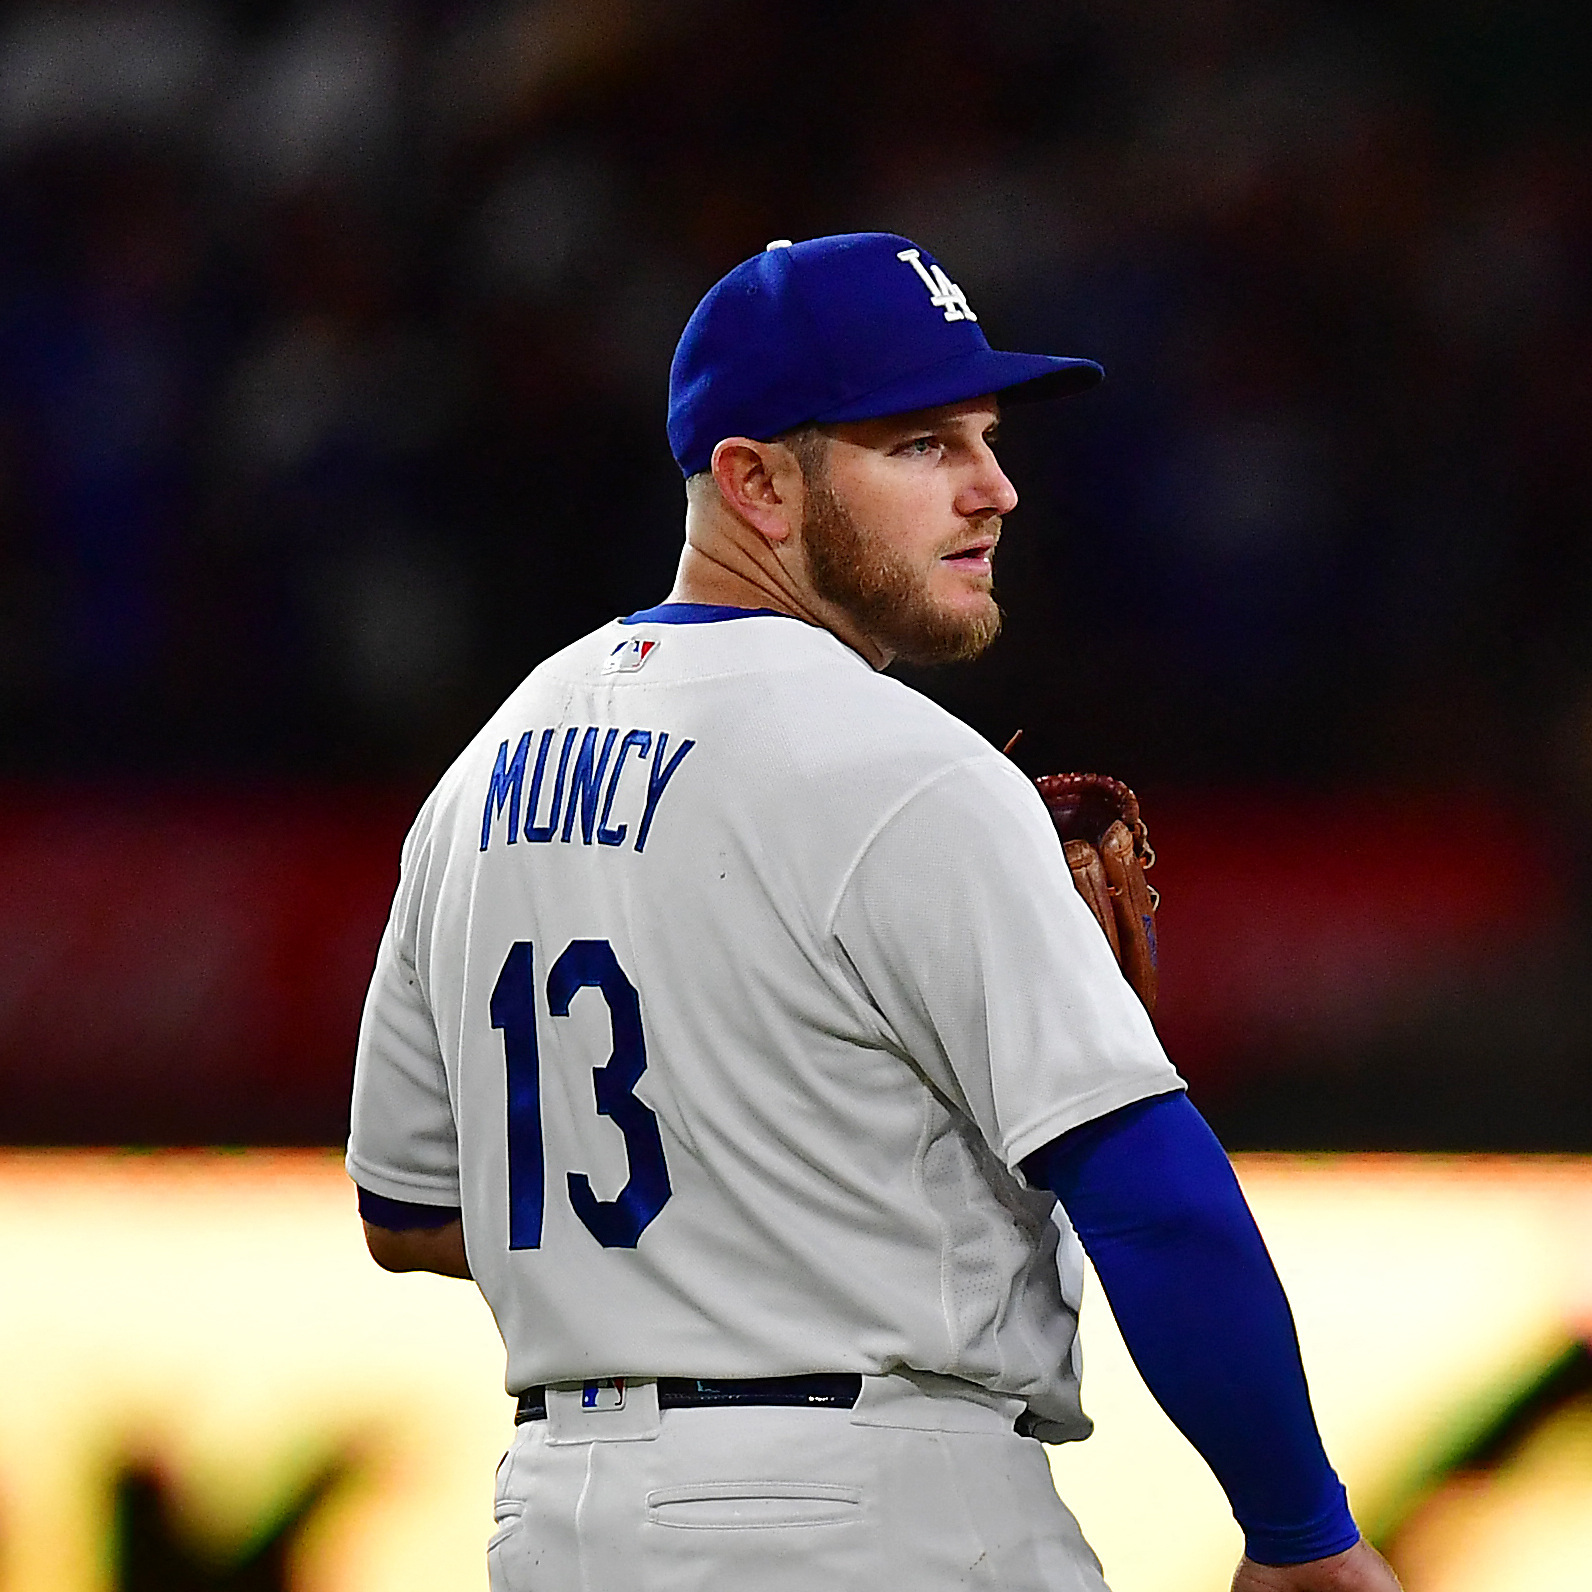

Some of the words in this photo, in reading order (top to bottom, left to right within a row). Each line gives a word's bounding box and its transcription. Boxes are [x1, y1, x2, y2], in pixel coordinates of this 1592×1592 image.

[897, 249, 978, 322] LA
[479, 726, 696, 853] MUNCY
[490, 938, 673, 1252] 13
